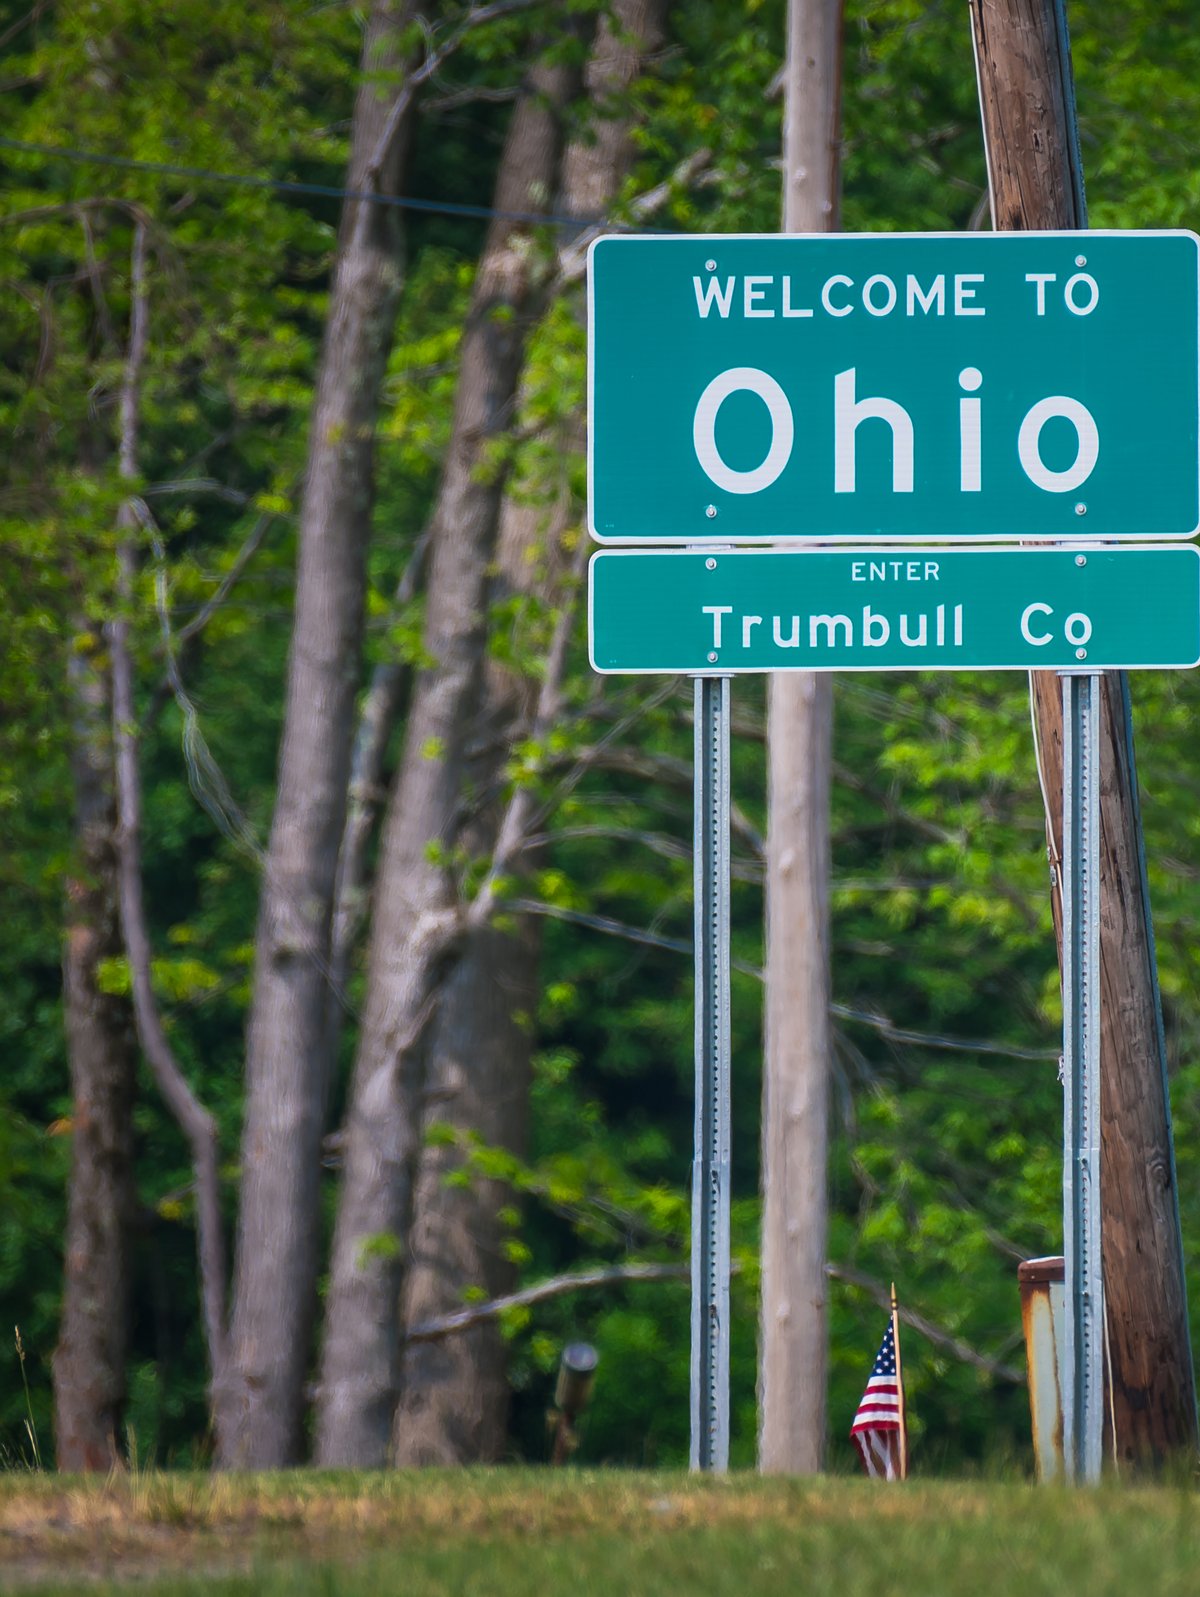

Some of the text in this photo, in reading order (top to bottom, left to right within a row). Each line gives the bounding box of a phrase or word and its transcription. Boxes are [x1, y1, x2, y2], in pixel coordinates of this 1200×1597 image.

[693, 273, 1100, 319] WELCOME TO
[692, 366, 1100, 495] Ohio
[851, 561, 941, 582] ENTER
[702, 602, 1093, 649] Trumbull Co
